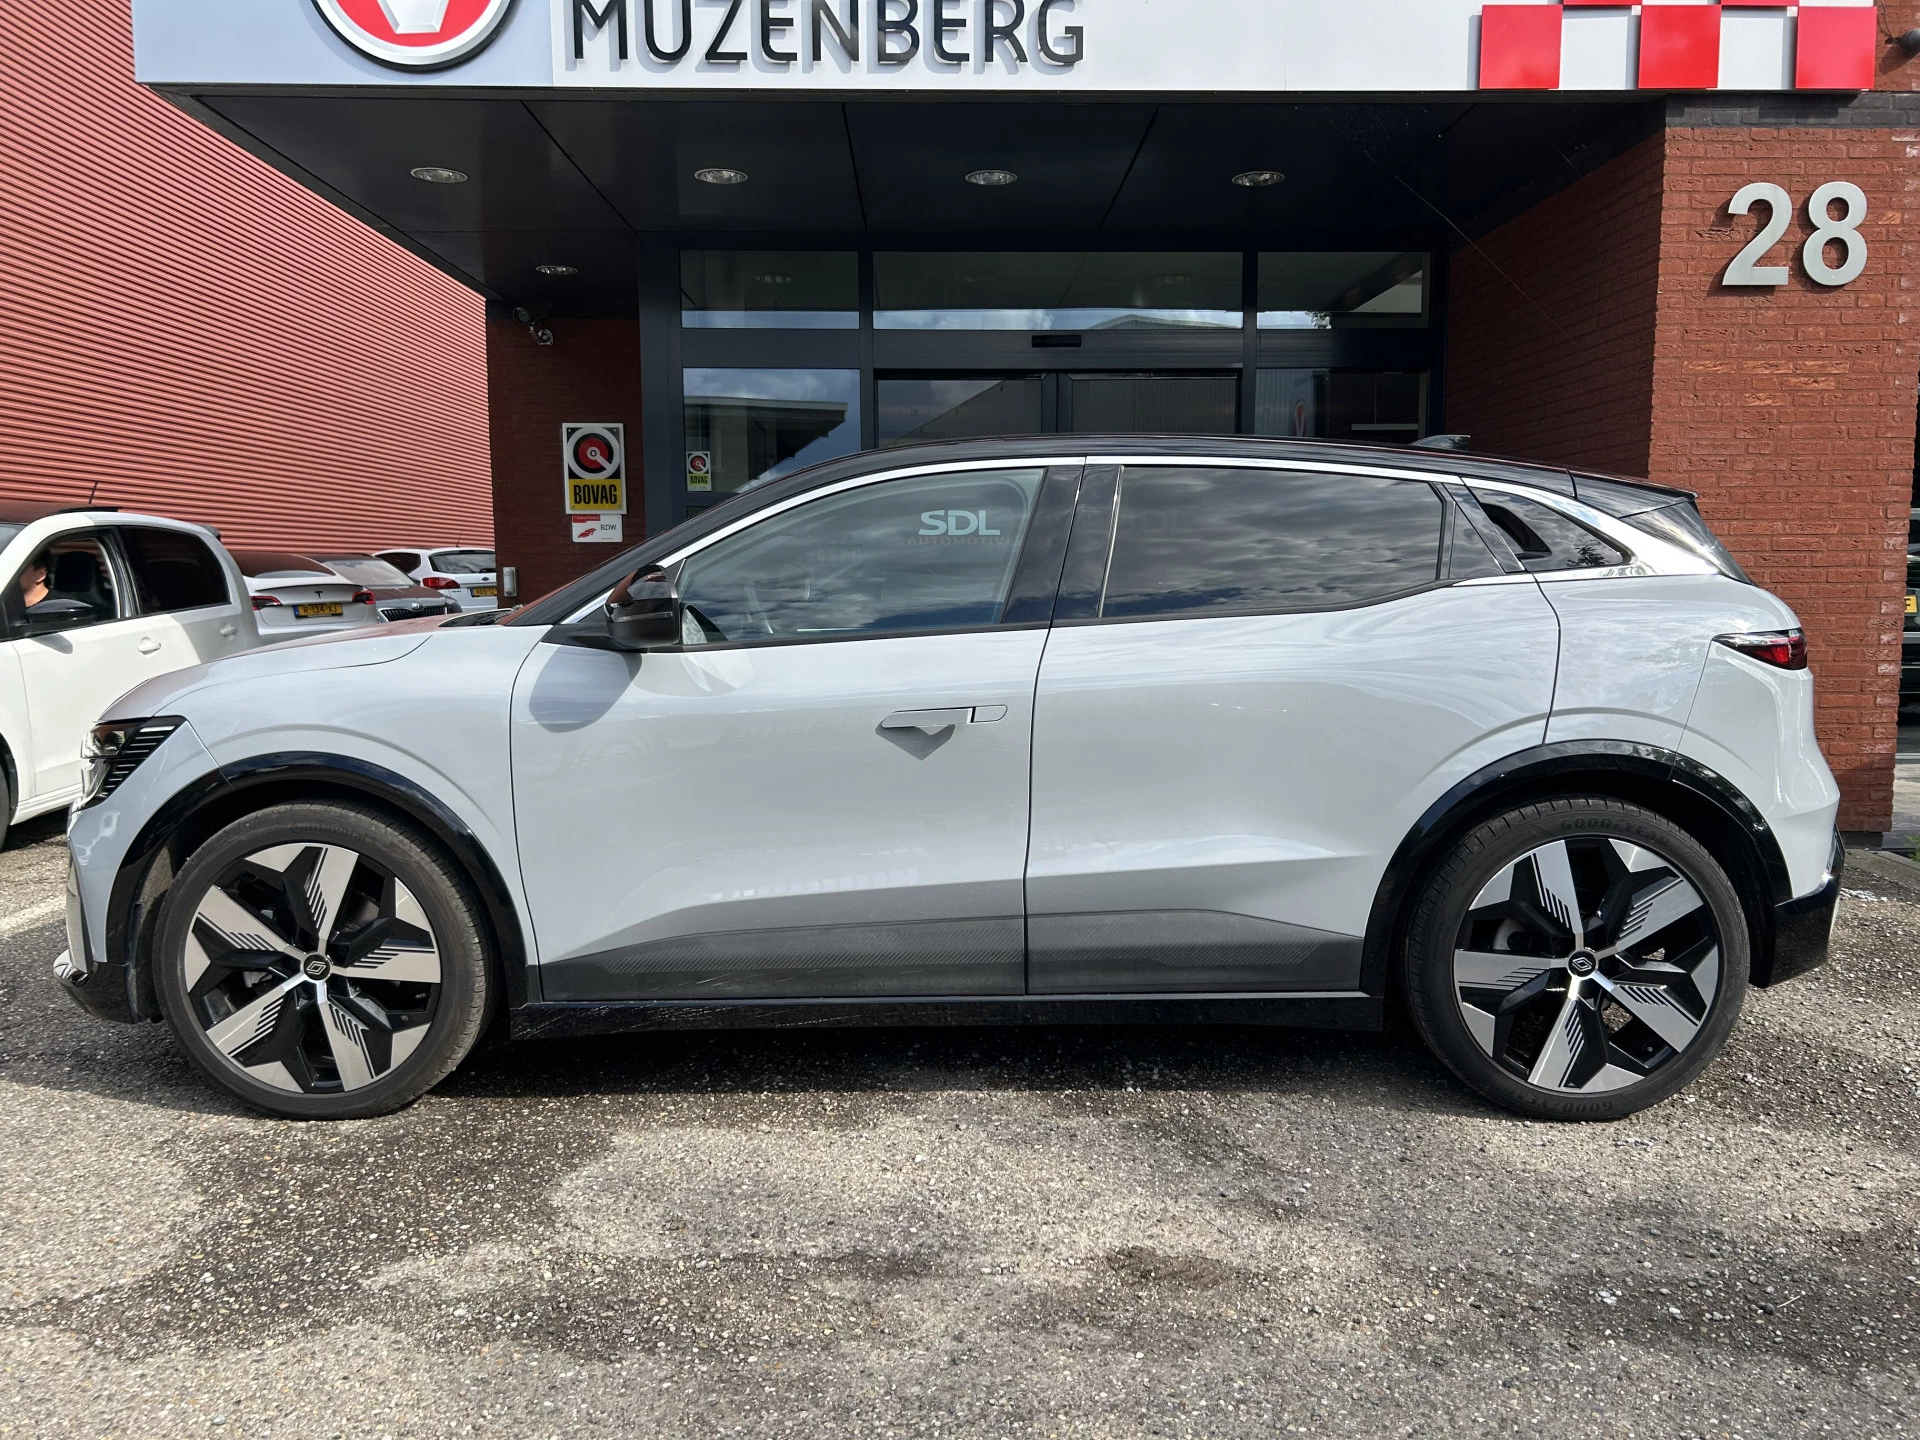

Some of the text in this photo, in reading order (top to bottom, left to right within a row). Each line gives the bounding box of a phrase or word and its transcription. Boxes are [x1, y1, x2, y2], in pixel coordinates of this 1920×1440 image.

[573, 0, 1084, 65] MUZENBERG
[1722, 181, 1868, 286] 28
[690, 475, 708, 485] BOVAG
[573, 484, 618, 505] BOVAG
[918, 509, 1001, 536] SDL
